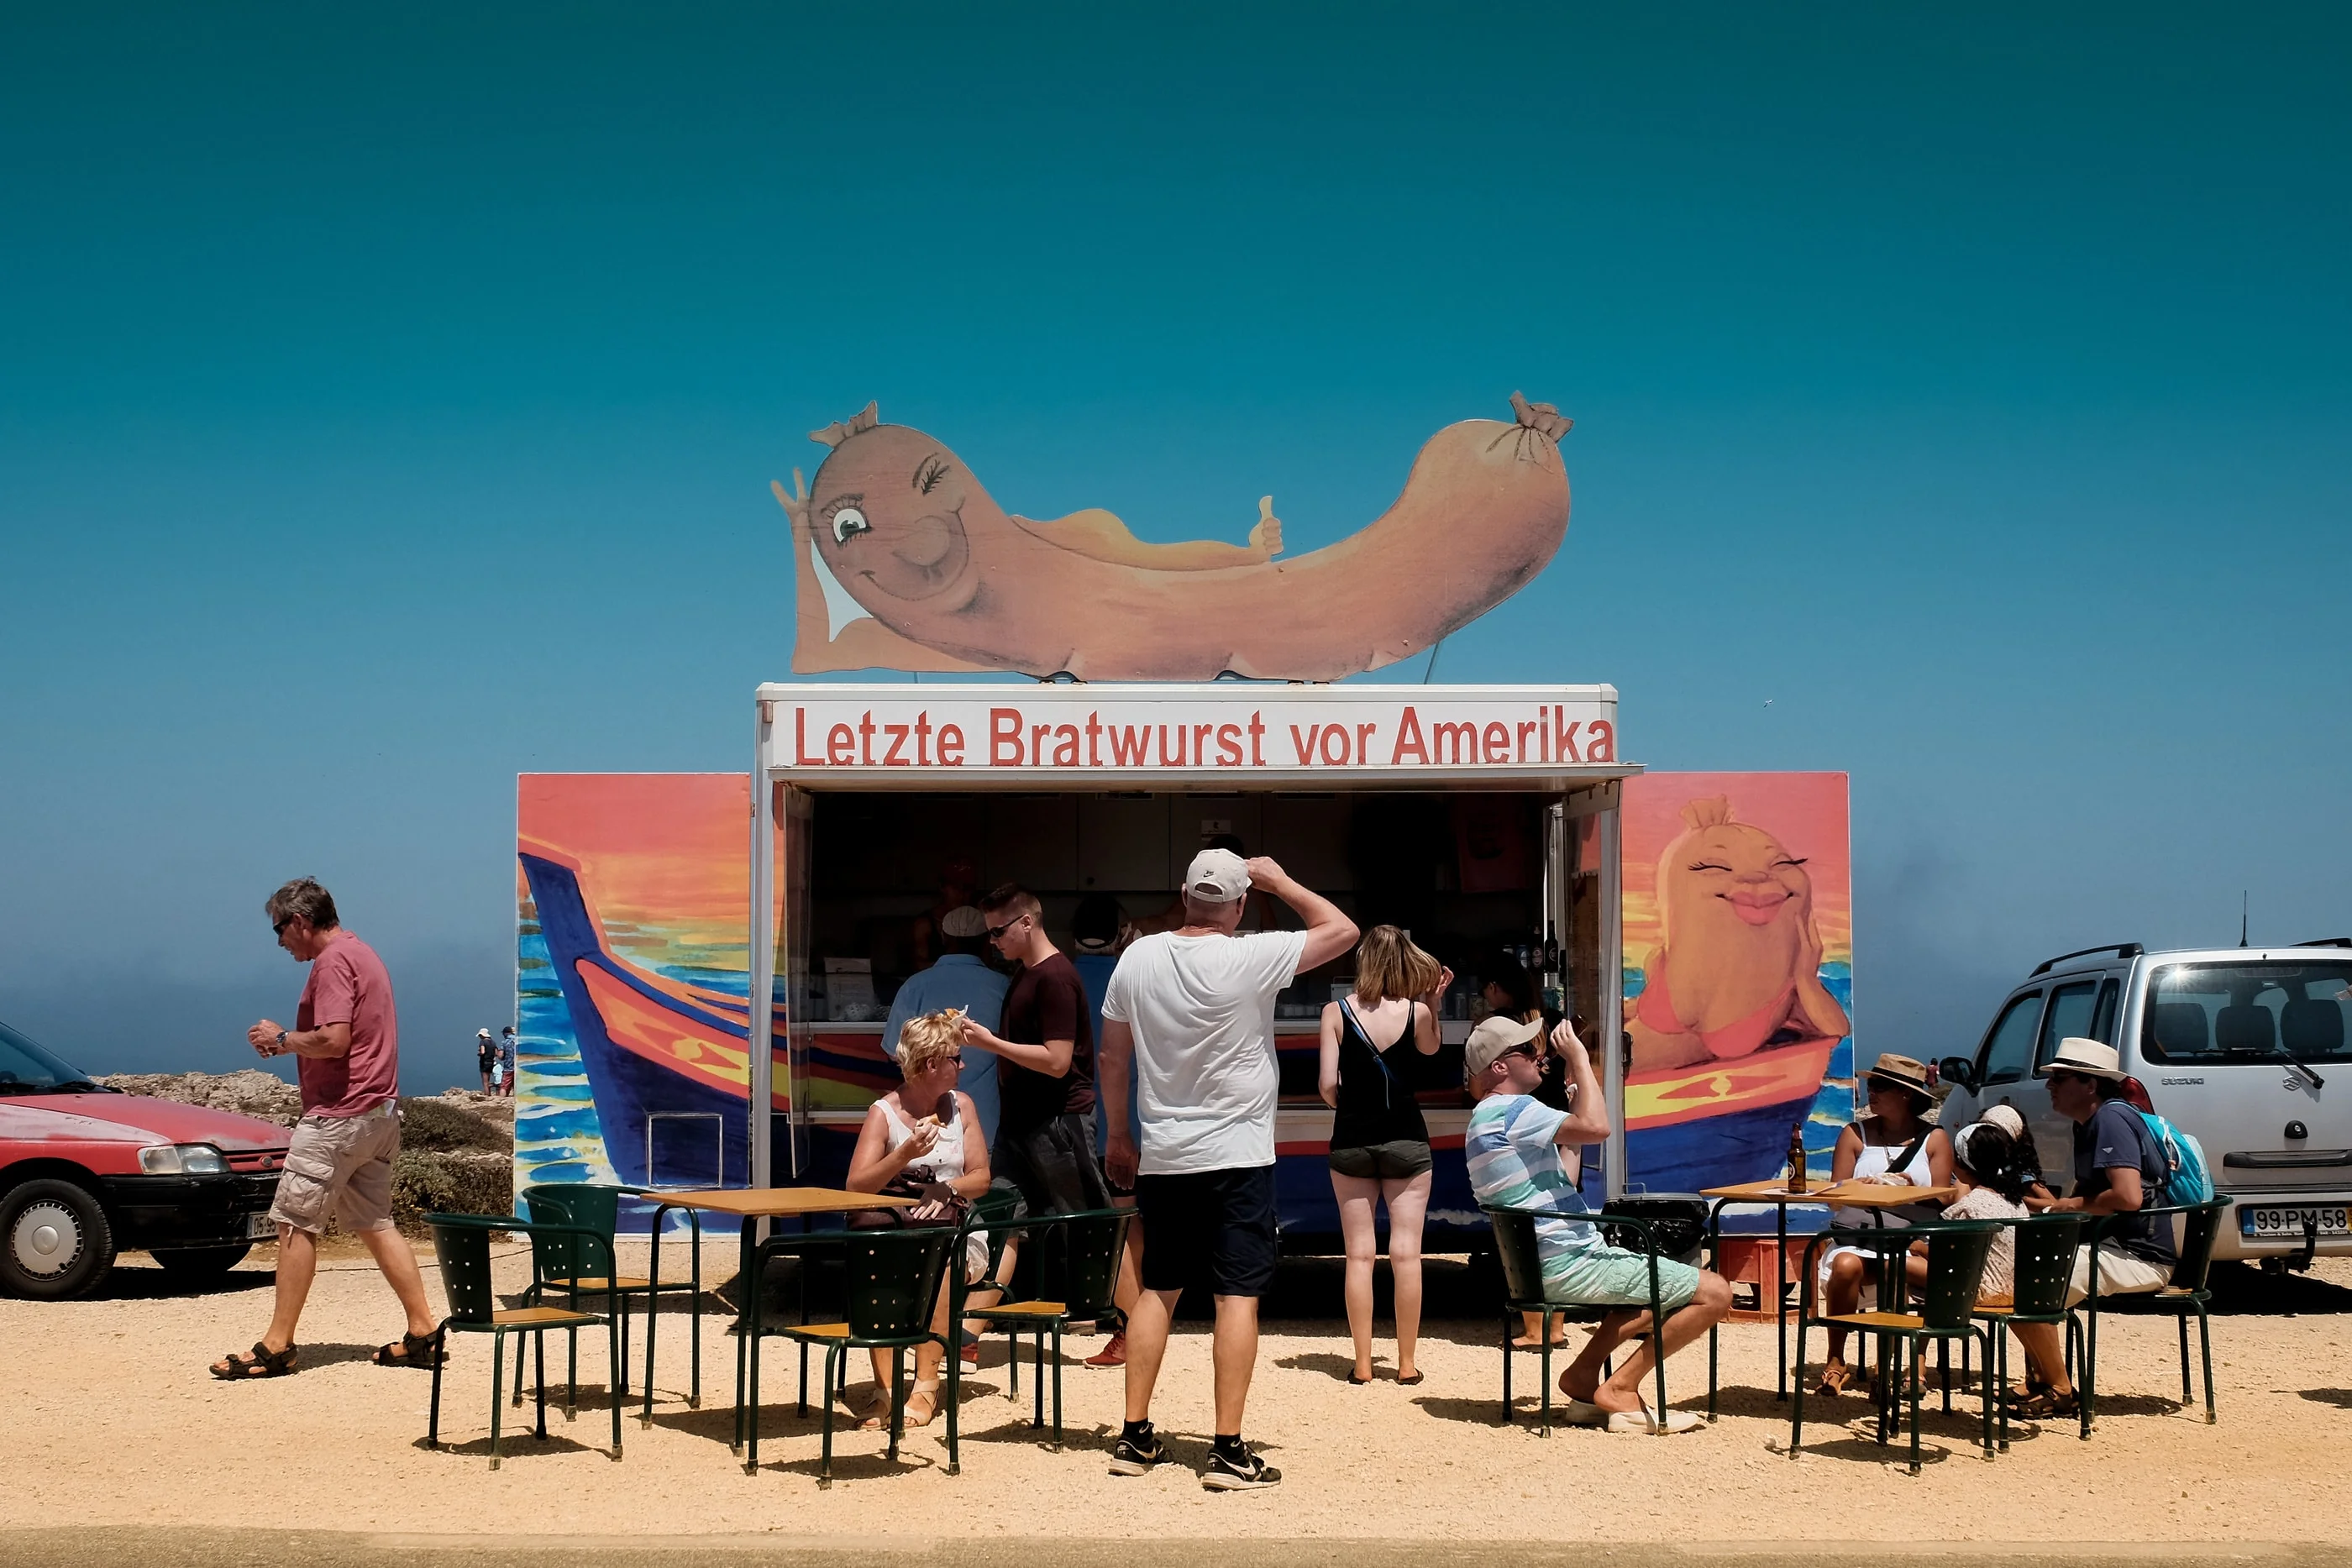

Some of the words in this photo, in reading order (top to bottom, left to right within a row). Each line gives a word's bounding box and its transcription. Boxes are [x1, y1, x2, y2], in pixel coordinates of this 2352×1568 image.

[794, 707, 966, 766] Letzte
[989, 707, 1267, 767] Bratwurst
[1289, 722, 1377, 766] vor
[1390, 705, 1614, 764] Amerika
